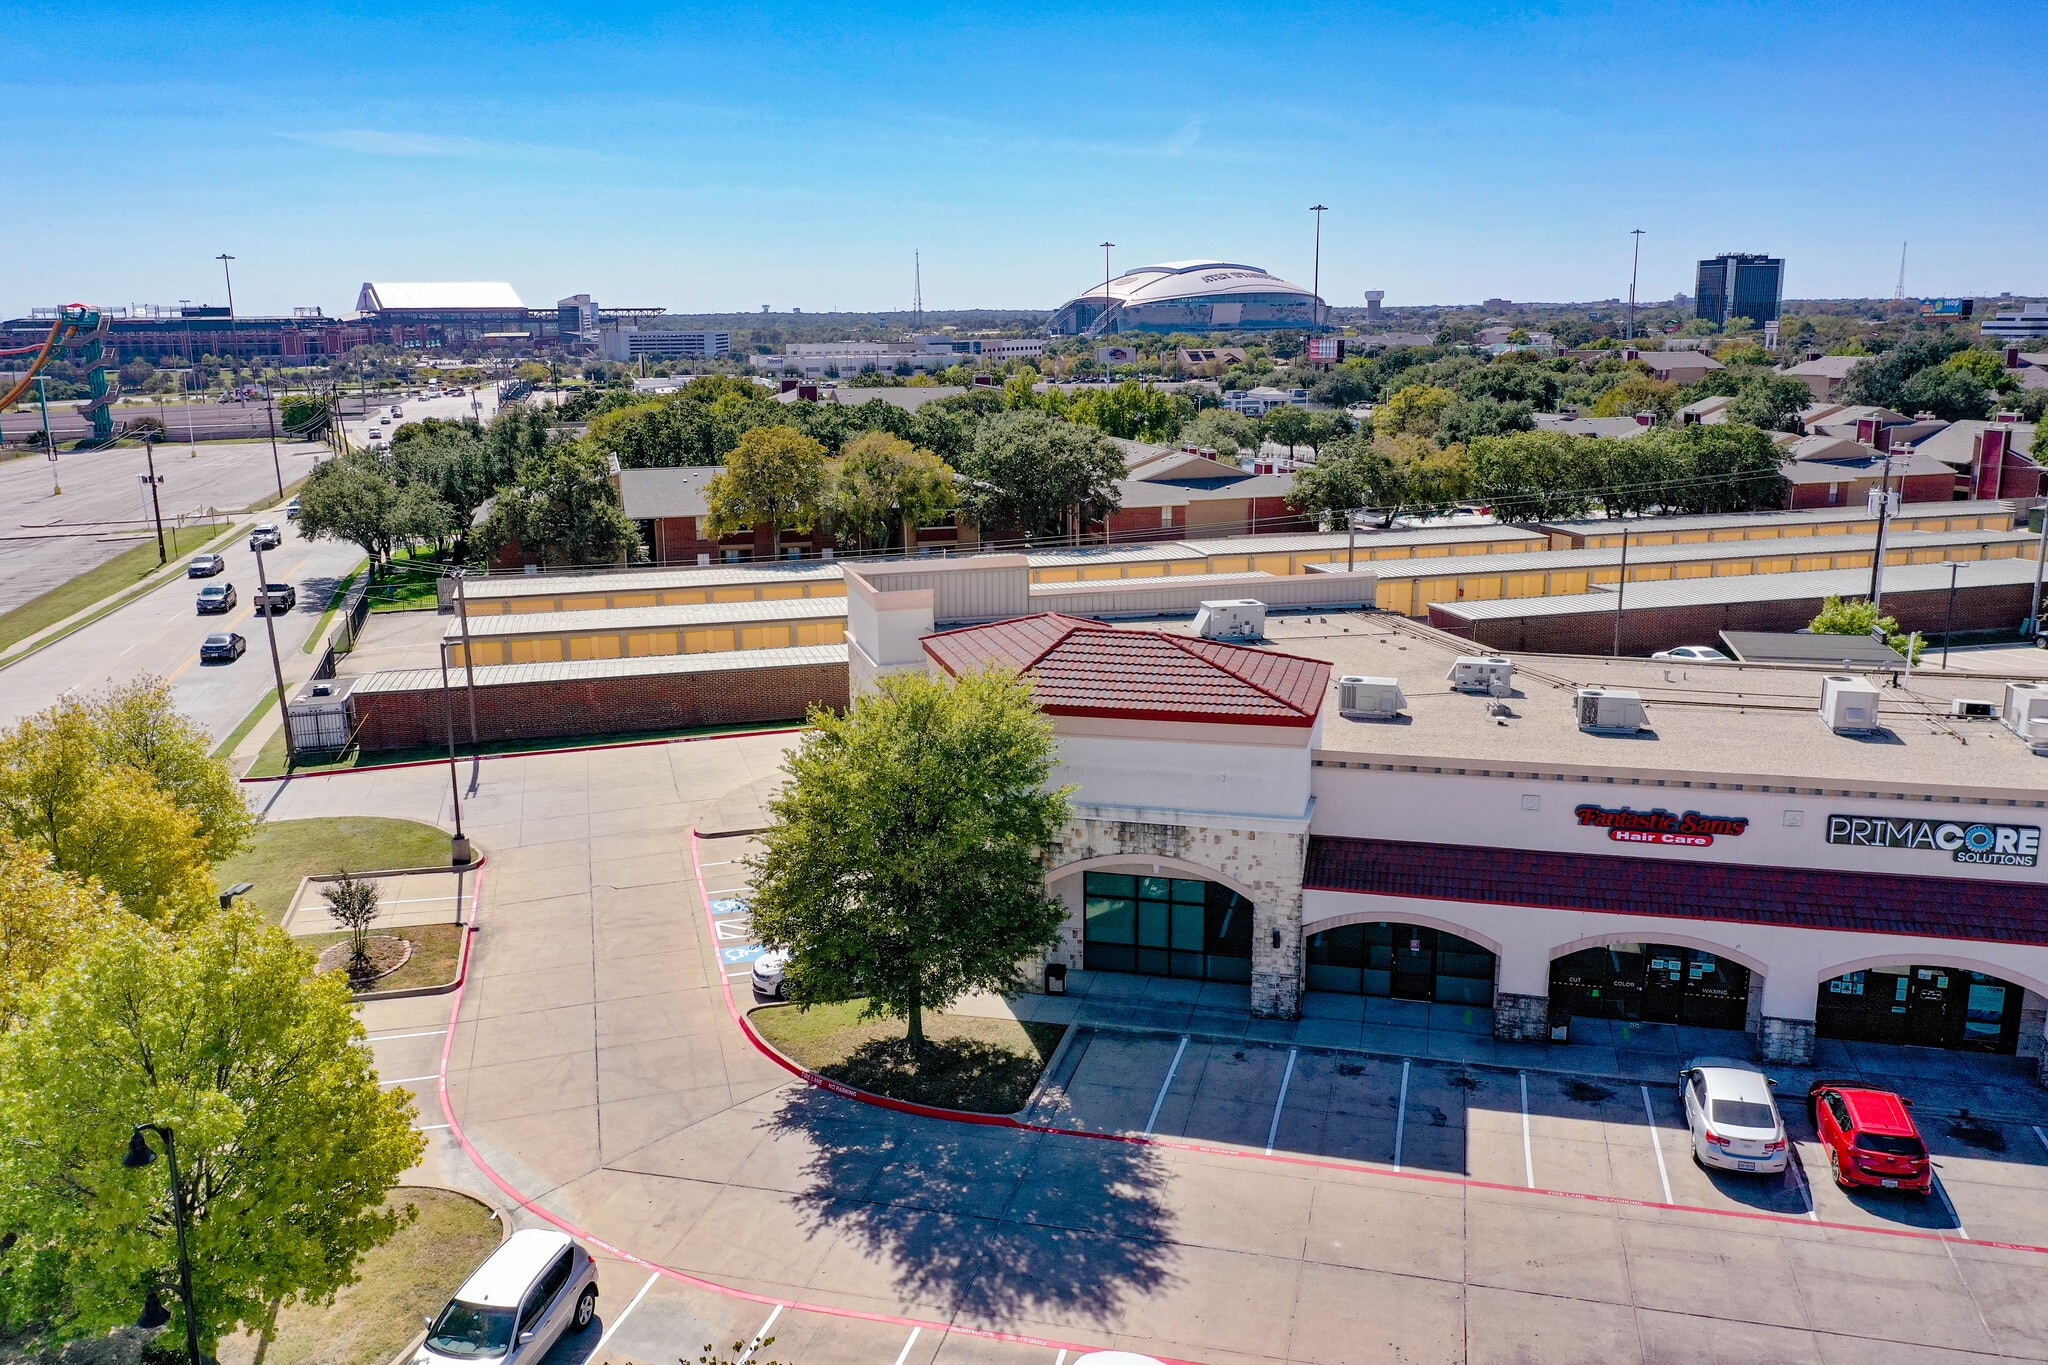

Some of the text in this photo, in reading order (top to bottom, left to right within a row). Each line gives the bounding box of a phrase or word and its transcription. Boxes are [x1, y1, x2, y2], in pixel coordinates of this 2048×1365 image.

[1577, 806, 1746, 835] Fantastic Sams
[1615, 831, 1707, 845] Hair Care
[1830, 818, 2039, 855] PRIMACORE
[1957, 852, 2033, 866] SOLUTIONS
[1702, 987, 1728, 996] WAXING
[811, 1075, 823, 1086] LANE
[836, 1086, 857, 1097] PARKING
[1609, 1198, 1643, 1206] PARKING
